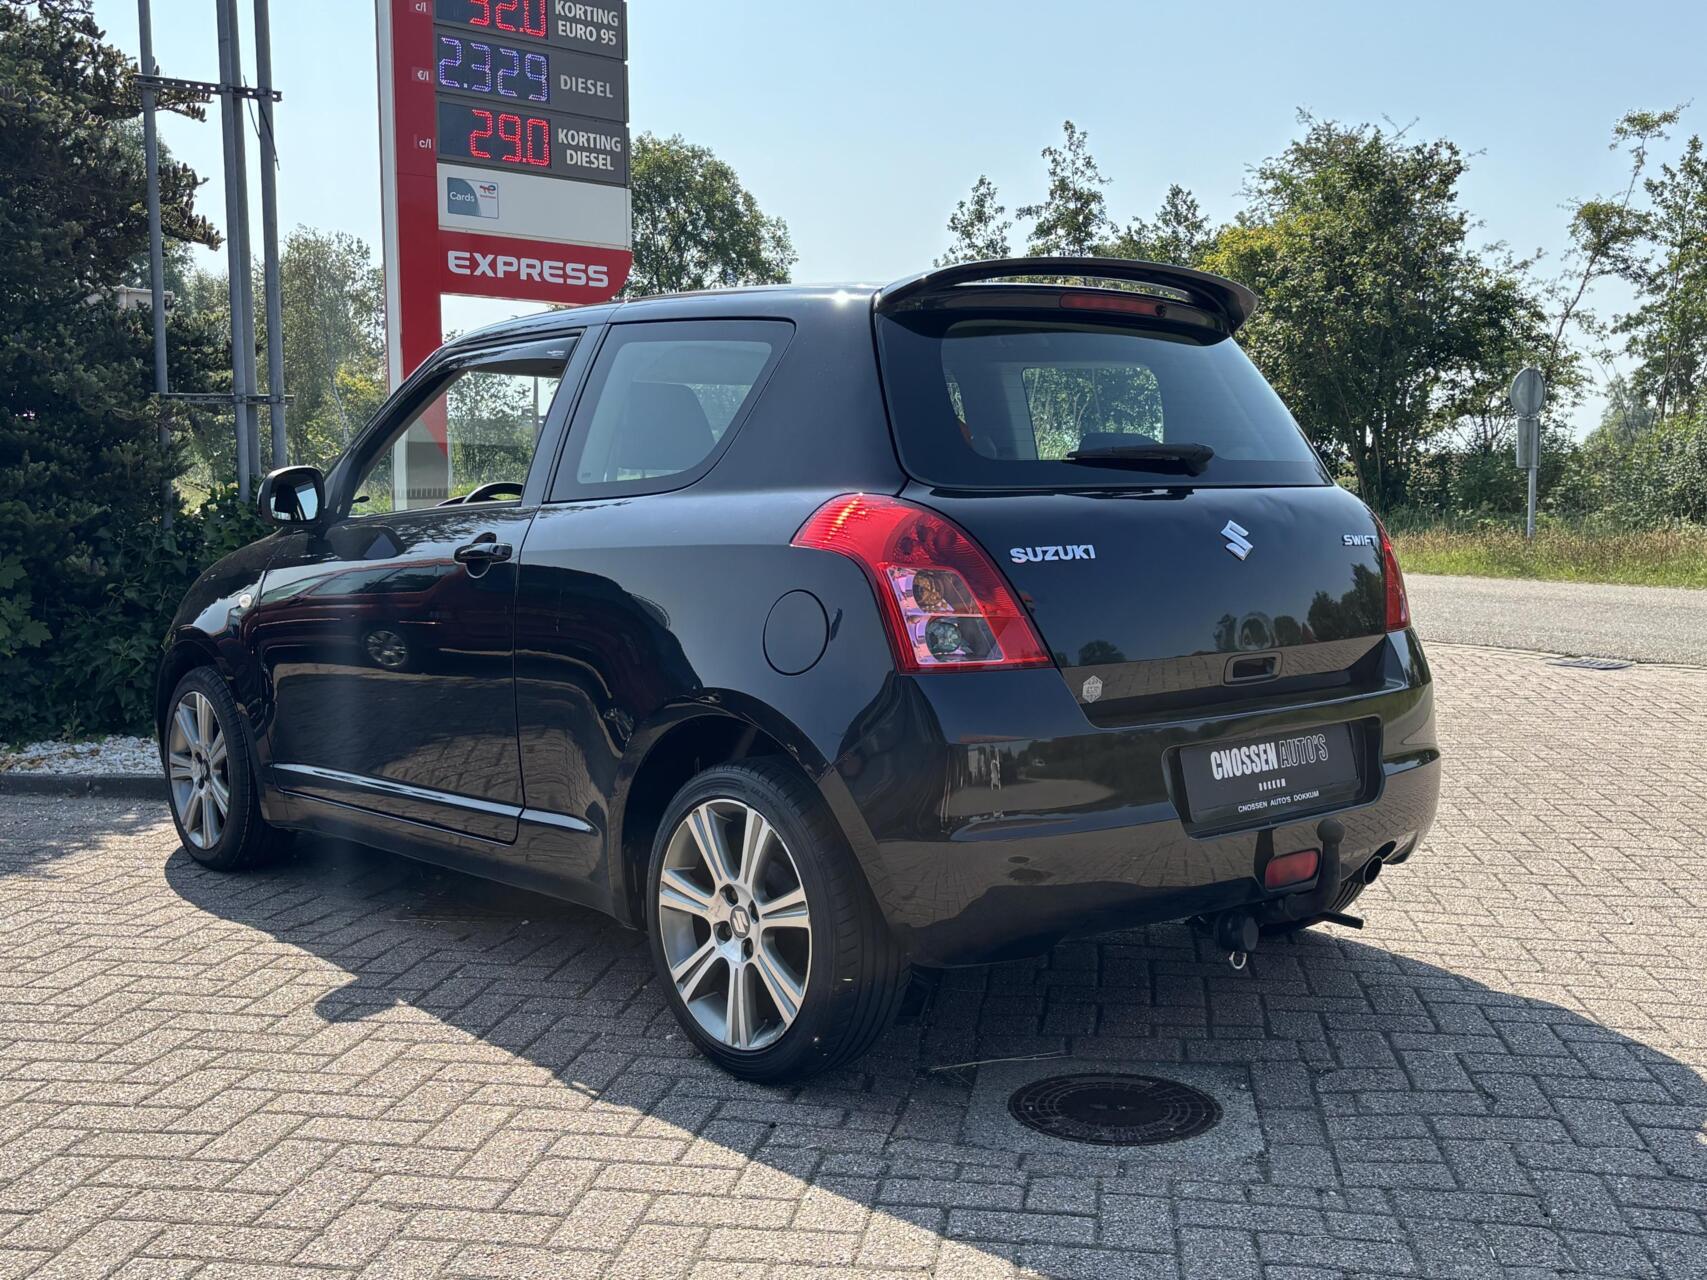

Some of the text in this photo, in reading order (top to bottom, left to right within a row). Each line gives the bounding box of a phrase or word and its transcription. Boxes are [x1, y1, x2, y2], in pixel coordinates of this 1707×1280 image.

[555, 0, 619, 27] KORTING
[558, 19, 617, 46] EURO 95
[417, 70, 429, 81] €/l
[439, 37, 549, 101] 2.329
[559, 74, 614, 98] DIESEL
[419, 138, 432, 149] c/l
[470, 109, 550, 167] 29.0
[558, 128, 622, 152] KORTING
[566, 149, 615, 171] DIESEL
[450, 191, 475, 202] Cards
[447, 250, 609, 288] EXPRESS
[1342, 534, 1377, 547] SWIFT
[1009, 544, 1096, 564] SUZUKI
[1210, 733, 1329, 780] CNOSSEN AUTO'S
[1237, 790, 1320, 813] CNOSSEN AUTO'S DOKKUM
